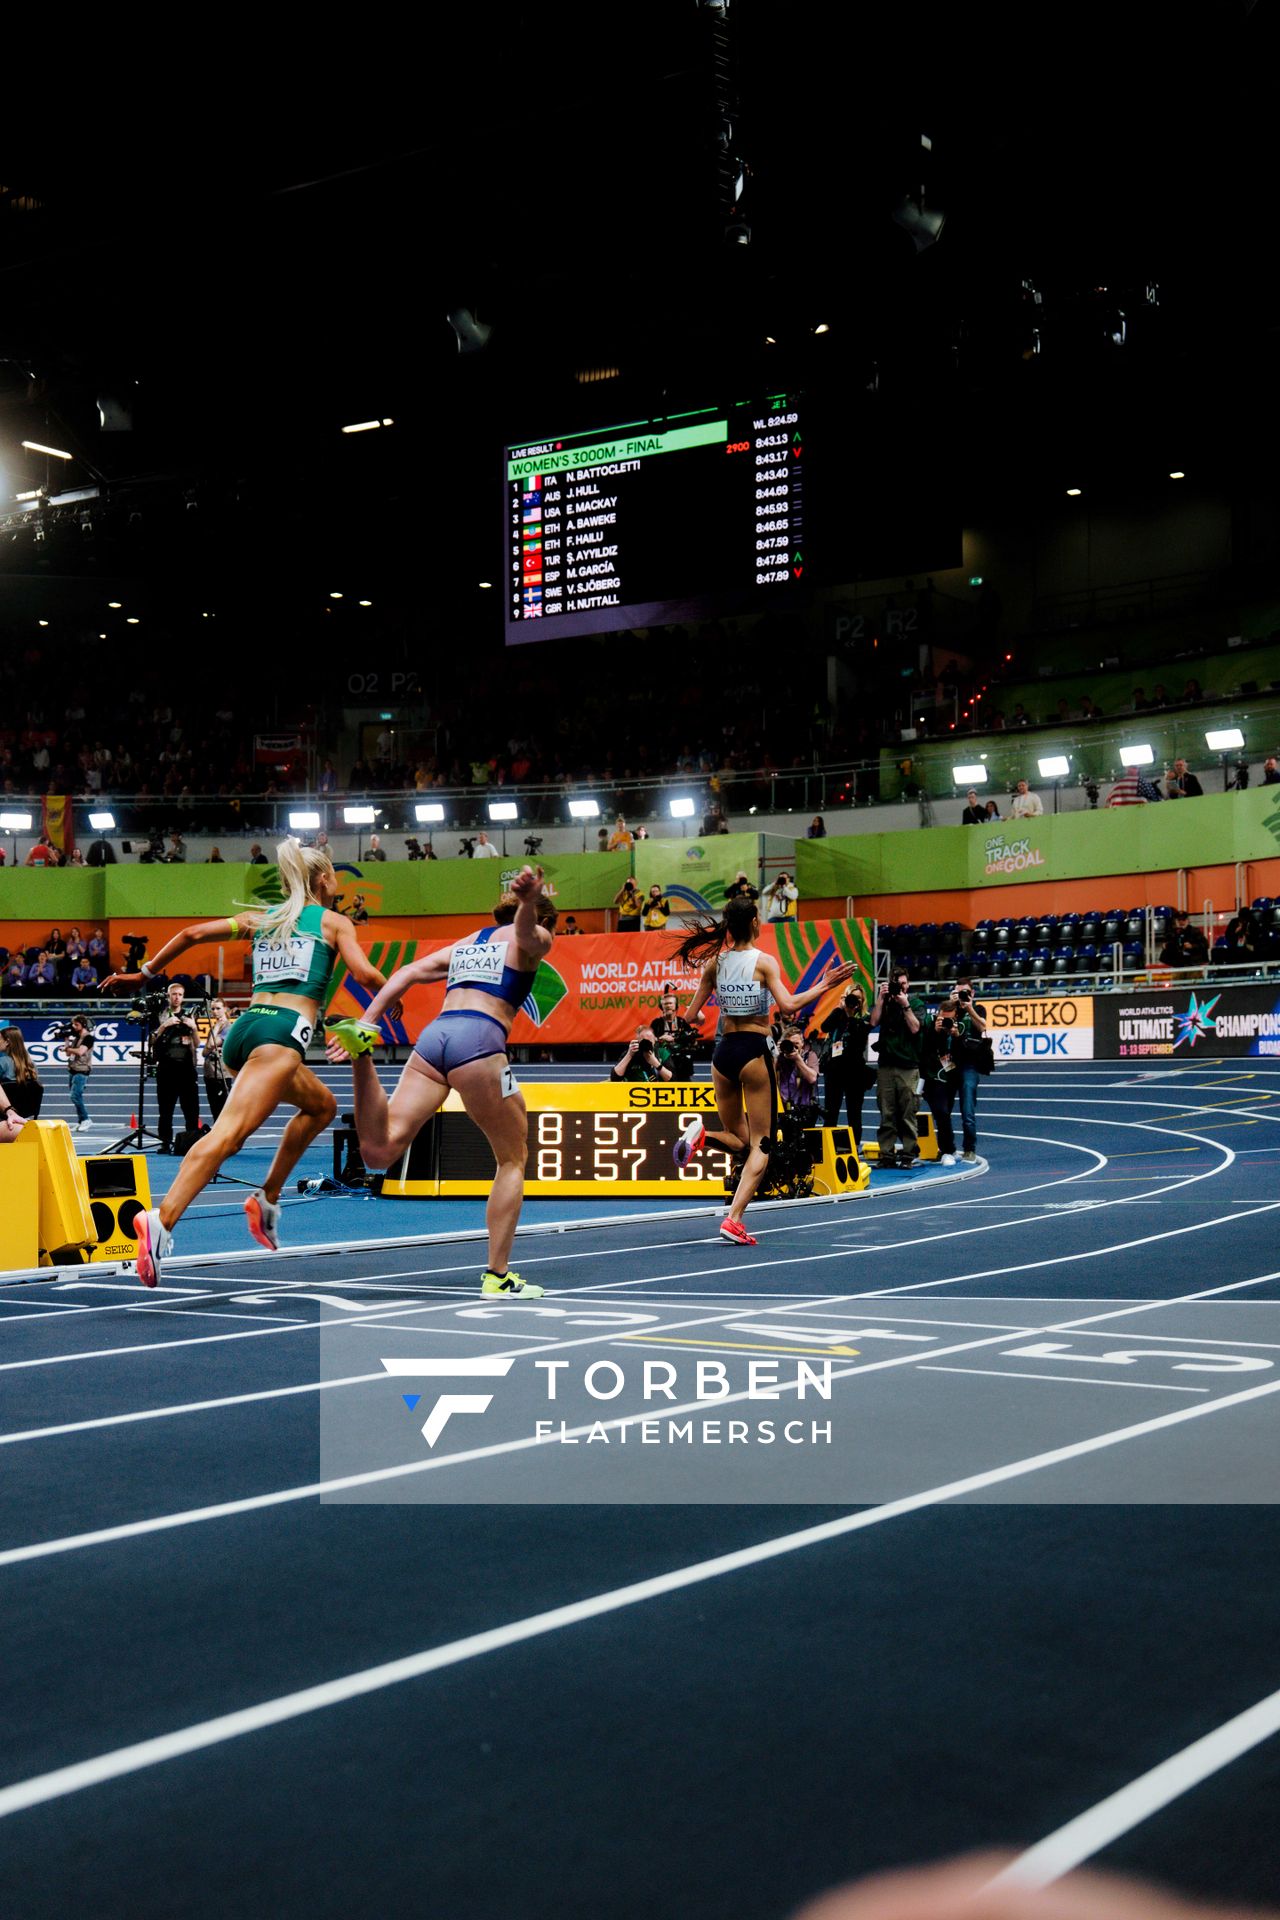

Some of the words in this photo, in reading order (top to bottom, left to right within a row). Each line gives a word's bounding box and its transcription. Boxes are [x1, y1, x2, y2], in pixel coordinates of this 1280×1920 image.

[753, 420, 767, 430] WL
[767, 413, 798, 428] 8:24.59
[511, 447, 527, 459] LIVE
[527, 443, 554, 456] RESULT
[512, 455, 569, 475] WOMEN'S
[572, 446, 616, 464] 3000M
[627, 437, 663, 454] FINAL
[726, 441, 750, 455] 2900
[513, 483, 518, 491] 1
[544, 476, 557, 487] ITA
[577, 459, 641, 480] BATTOCLETTI
[755, 433, 788, 448] 8:43.13
[512, 499, 519, 508] 2
[544, 490, 561, 503] AUS
[576, 484, 600, 497] HULL
[755, 450, 788, 465] 8:43.17
[512, 514, 519, 524] 3
[544, 506, 561, 519] USA
[576, 496, 617, 513] MACKAY
[755, 467, 788, 482] 8:43.40
[512, 531, 519, 539] 4
[544, 523, 560, 535] ETH
[577, 513, 616, 529] BAWEKE
[755, 484, 788, 499] 8:44.69
[512, 546, 519, 555] 5
[544, 539, 560, 551] ETH
[575, 531, 604, 545] HAILU
[755, 501, 788, 516] 8:45.93
[512, 562, 519, 571] 6
[544, 555, 560, 566] TUR
[576, 545, 618, 562] AYYILDIZ
[755, 518, 789, 533] 8:46.65
[513, 578, 519, 587] 7
[545, 571, 560, 583] ESP
[755, 536, 789, 550] 8:47.59
[513, 594, 519, 603] 8
[545, 587, 562, 598] SWE
[756, 553, 789, 567] 8:47.88
[513, 610, 519, 618] 9
[545, 603, 562, 614] GBR
[577, 594, 620, 610] NUTTALL
[756, 570, 789, 584] 8:47.89
[985, 835, 1005, 849] ONE
[985, 839, 1030, 864] TRACK
[1004, 849, 1045, 873] GOAL
[455, 945, 500, 957] SONY
[260, 956, 300, 970] HULL
[451, 957, 501, 973] MACKAY
[581, 962, 638, 979] WORLD
[580, 981, 626, 994] INDOOR
[720, 984, 755, 993] SONY
[580, 996, 635, 1009] KUJAWY
[1119, 1008, 1140, 1016] WORLD
[1140, 1006, 1174, 1015] ATHLETICS
[992, 1001, 1077, 1027] SEIKO
[300, 1026, 311, 1042] 6
[1119, 1018, 1174, 1041] ULTIMATE
[1015, 1032, 1069, 1055] TDK
[1119, 1044, 1138, 1055] 11-13
[1138, 1043, 1174, 1055] SEPTEMBER
[505, 1070, 512, 1090] 7
[629, 1087, 717, 1107] SEIK
[105, 1244, 134, 1255] SEIKO
